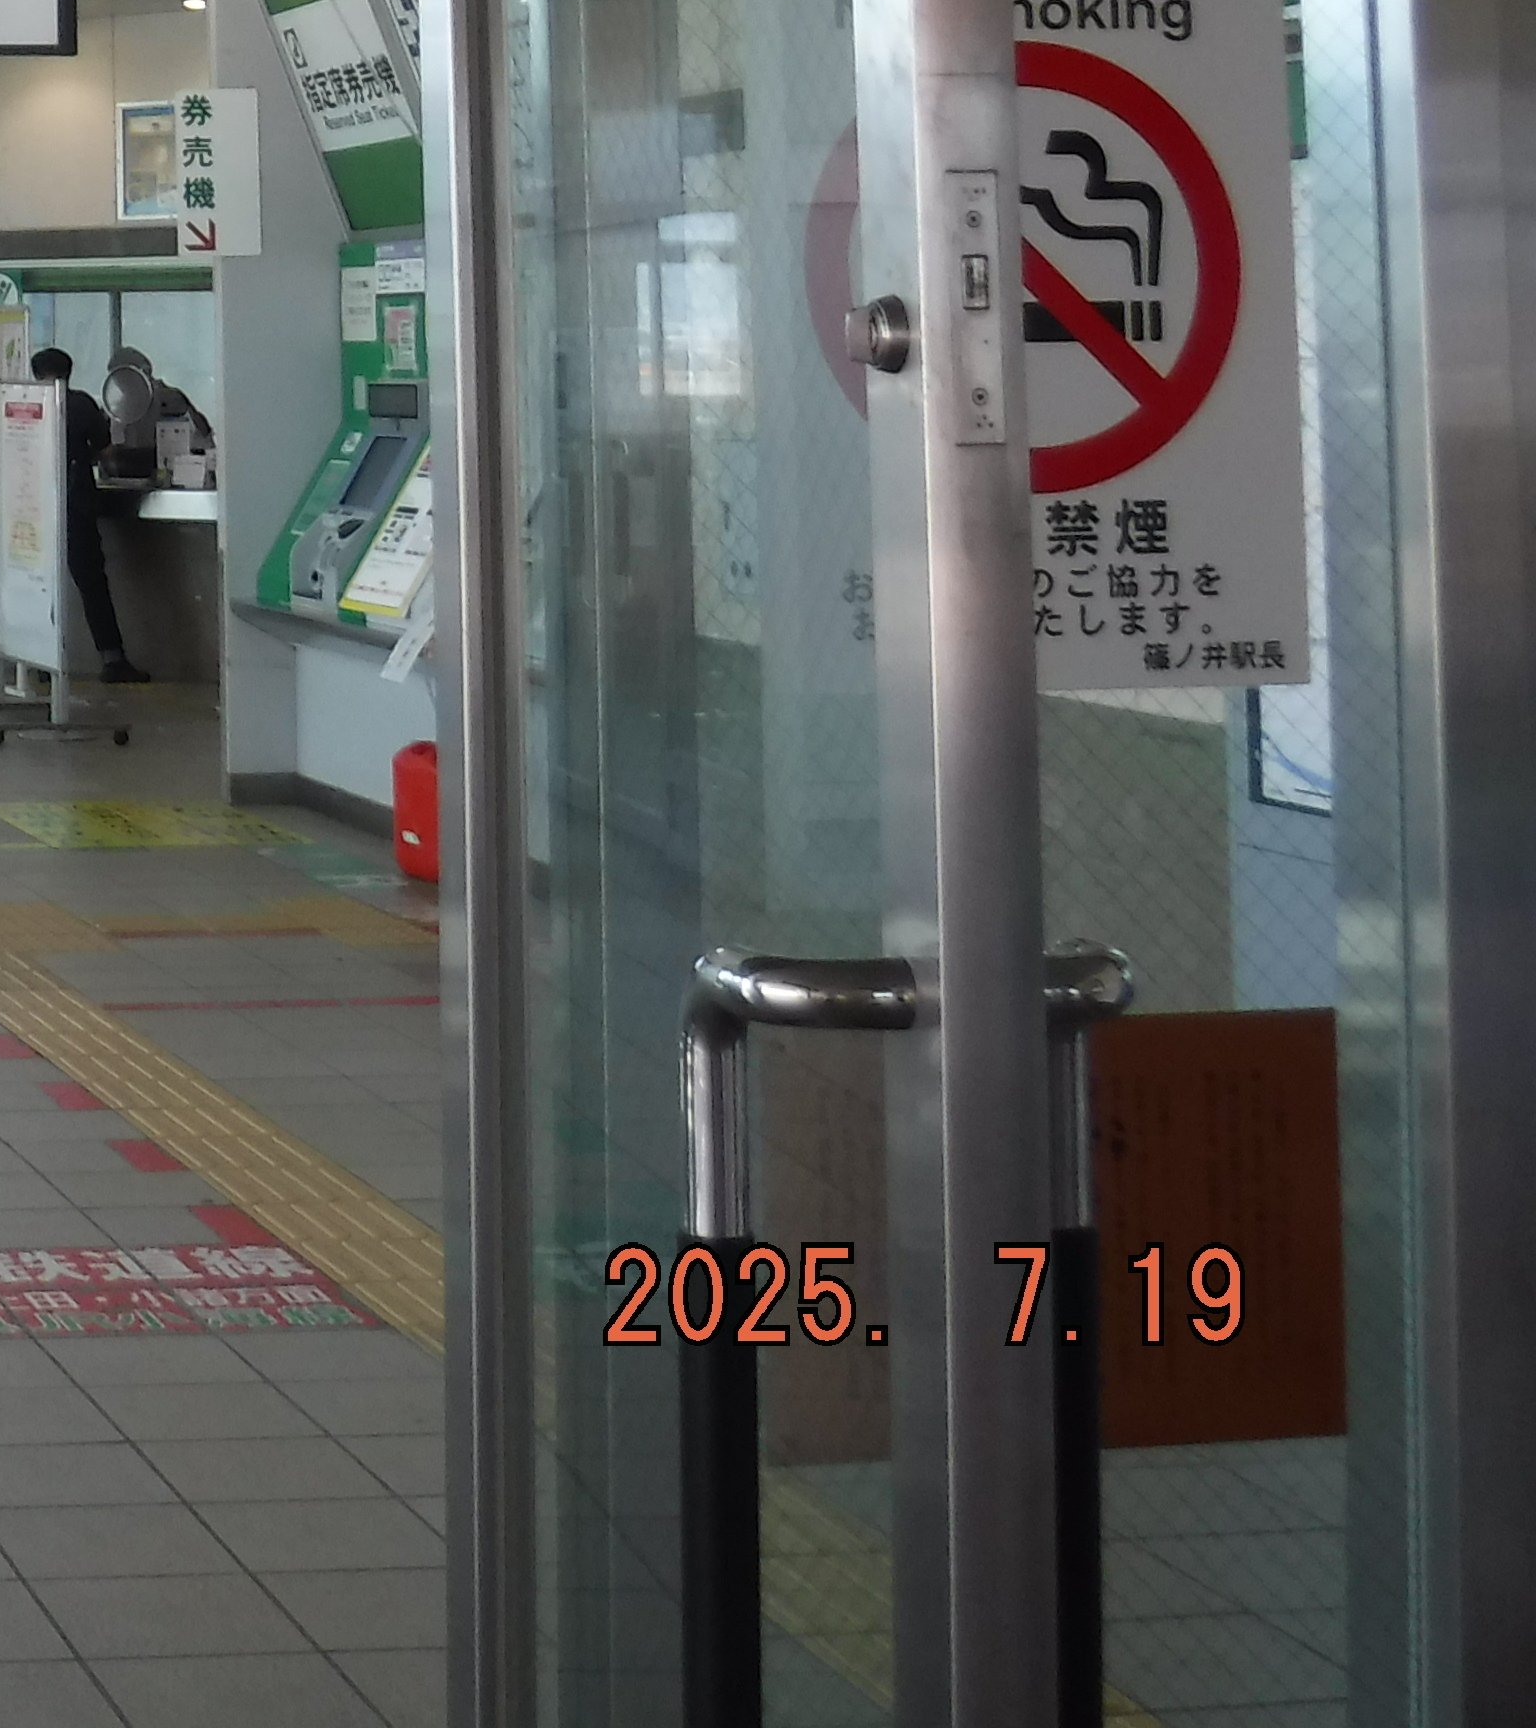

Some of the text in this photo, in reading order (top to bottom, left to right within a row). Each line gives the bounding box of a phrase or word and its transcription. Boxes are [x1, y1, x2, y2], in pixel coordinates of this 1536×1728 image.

[302, 53, 401, 114] 指定席券売機
[181, 93, 216, 211] 券売機
[1144, 640, 1286, 671] 篠ノ井駅長
